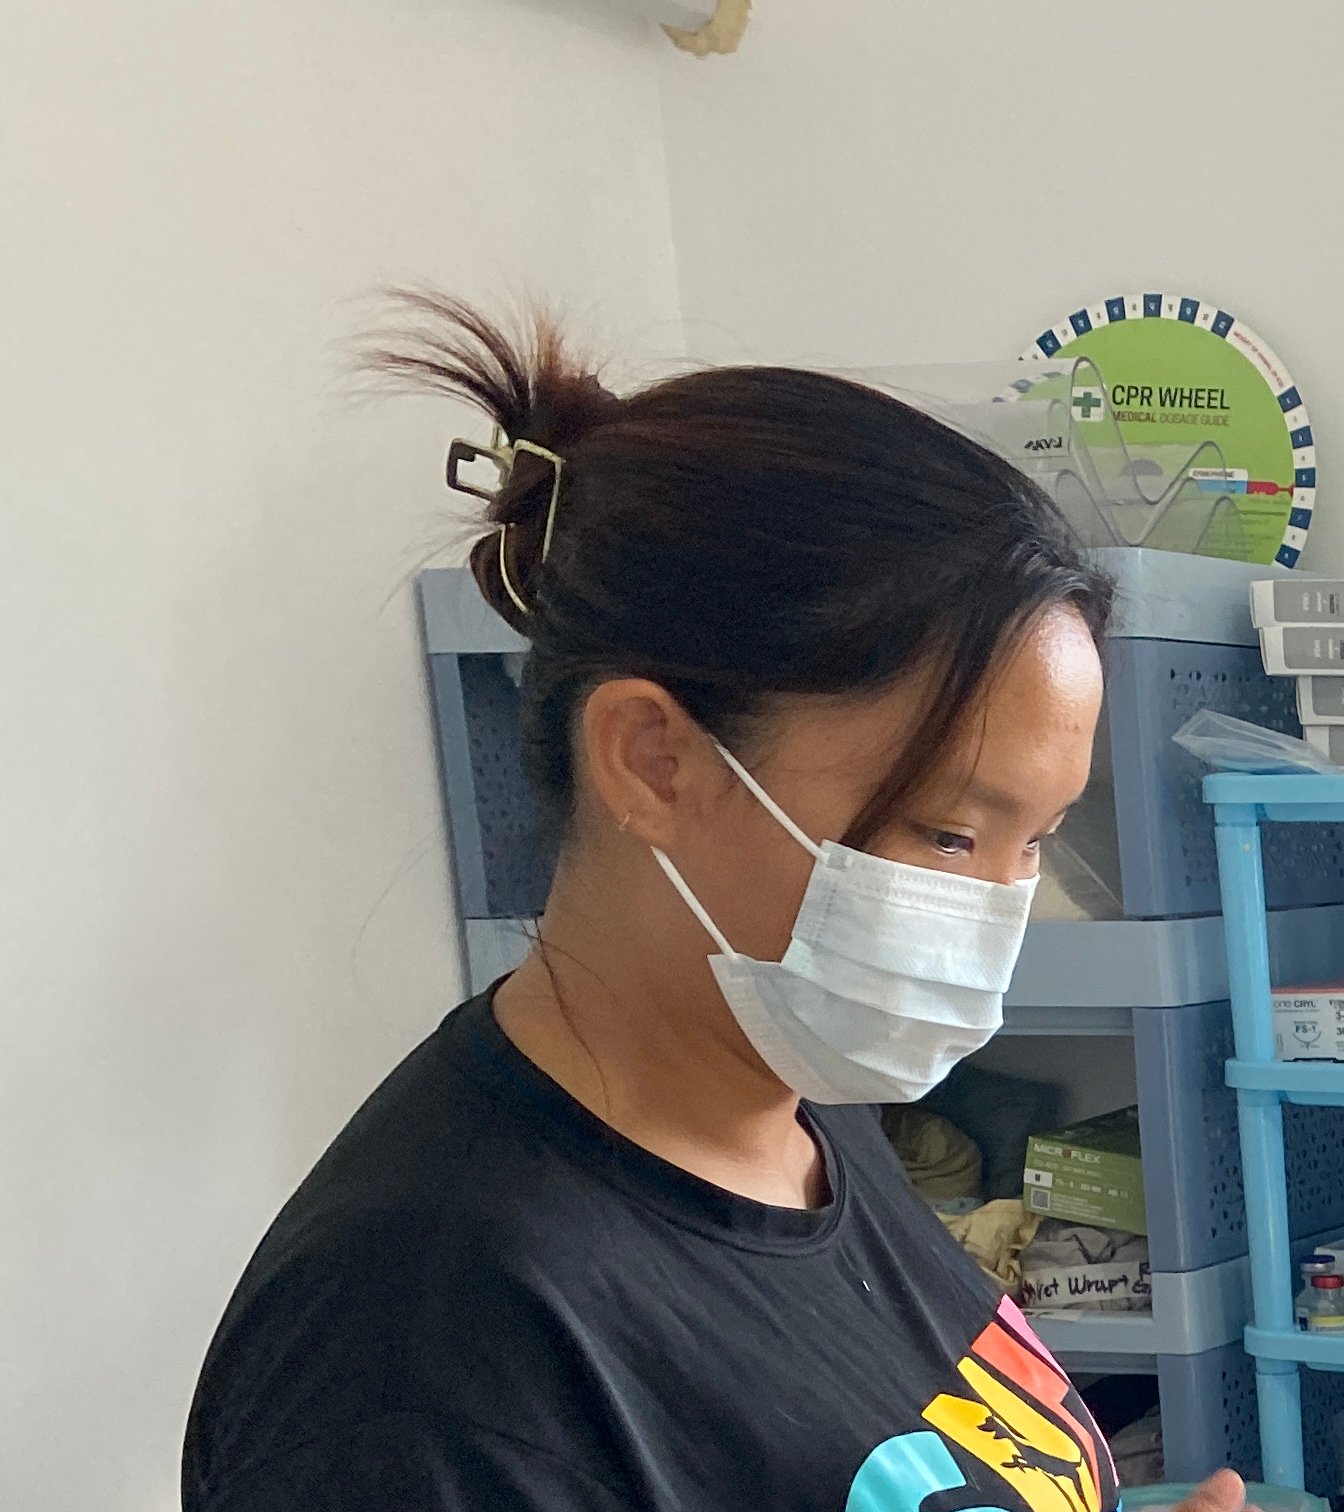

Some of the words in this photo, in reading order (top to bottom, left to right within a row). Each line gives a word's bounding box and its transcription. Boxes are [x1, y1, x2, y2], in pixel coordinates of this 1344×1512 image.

[1112, 385, 1152, 407] CPR
[1159, 386, 1230, 409] WHEEL
[1114, 411, 1156, 422] MEDICAL
